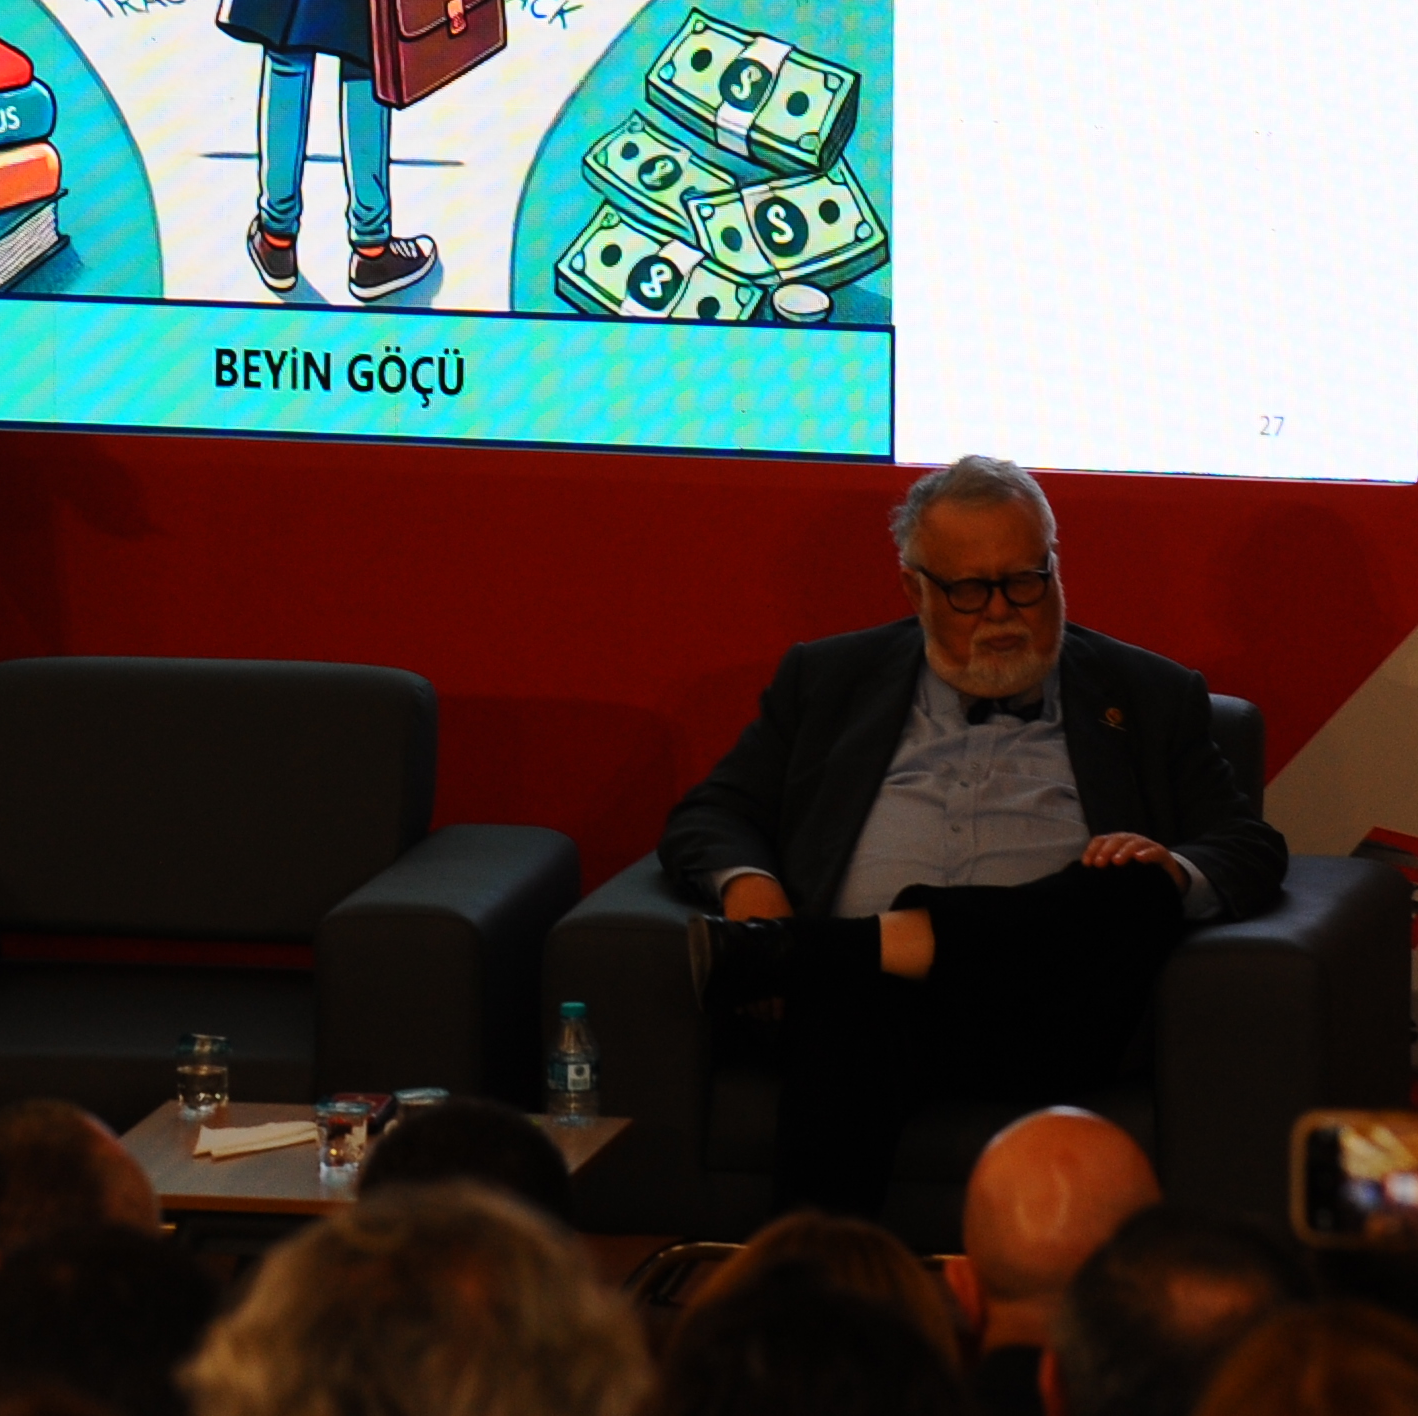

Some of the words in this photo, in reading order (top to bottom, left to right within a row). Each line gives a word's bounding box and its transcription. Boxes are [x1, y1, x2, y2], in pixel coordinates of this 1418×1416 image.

[214, 346, 331, 392] BEYİN
[346, 346, 466, 408] GÖÇÜ
[1259, 415, 1285, 436] 27
